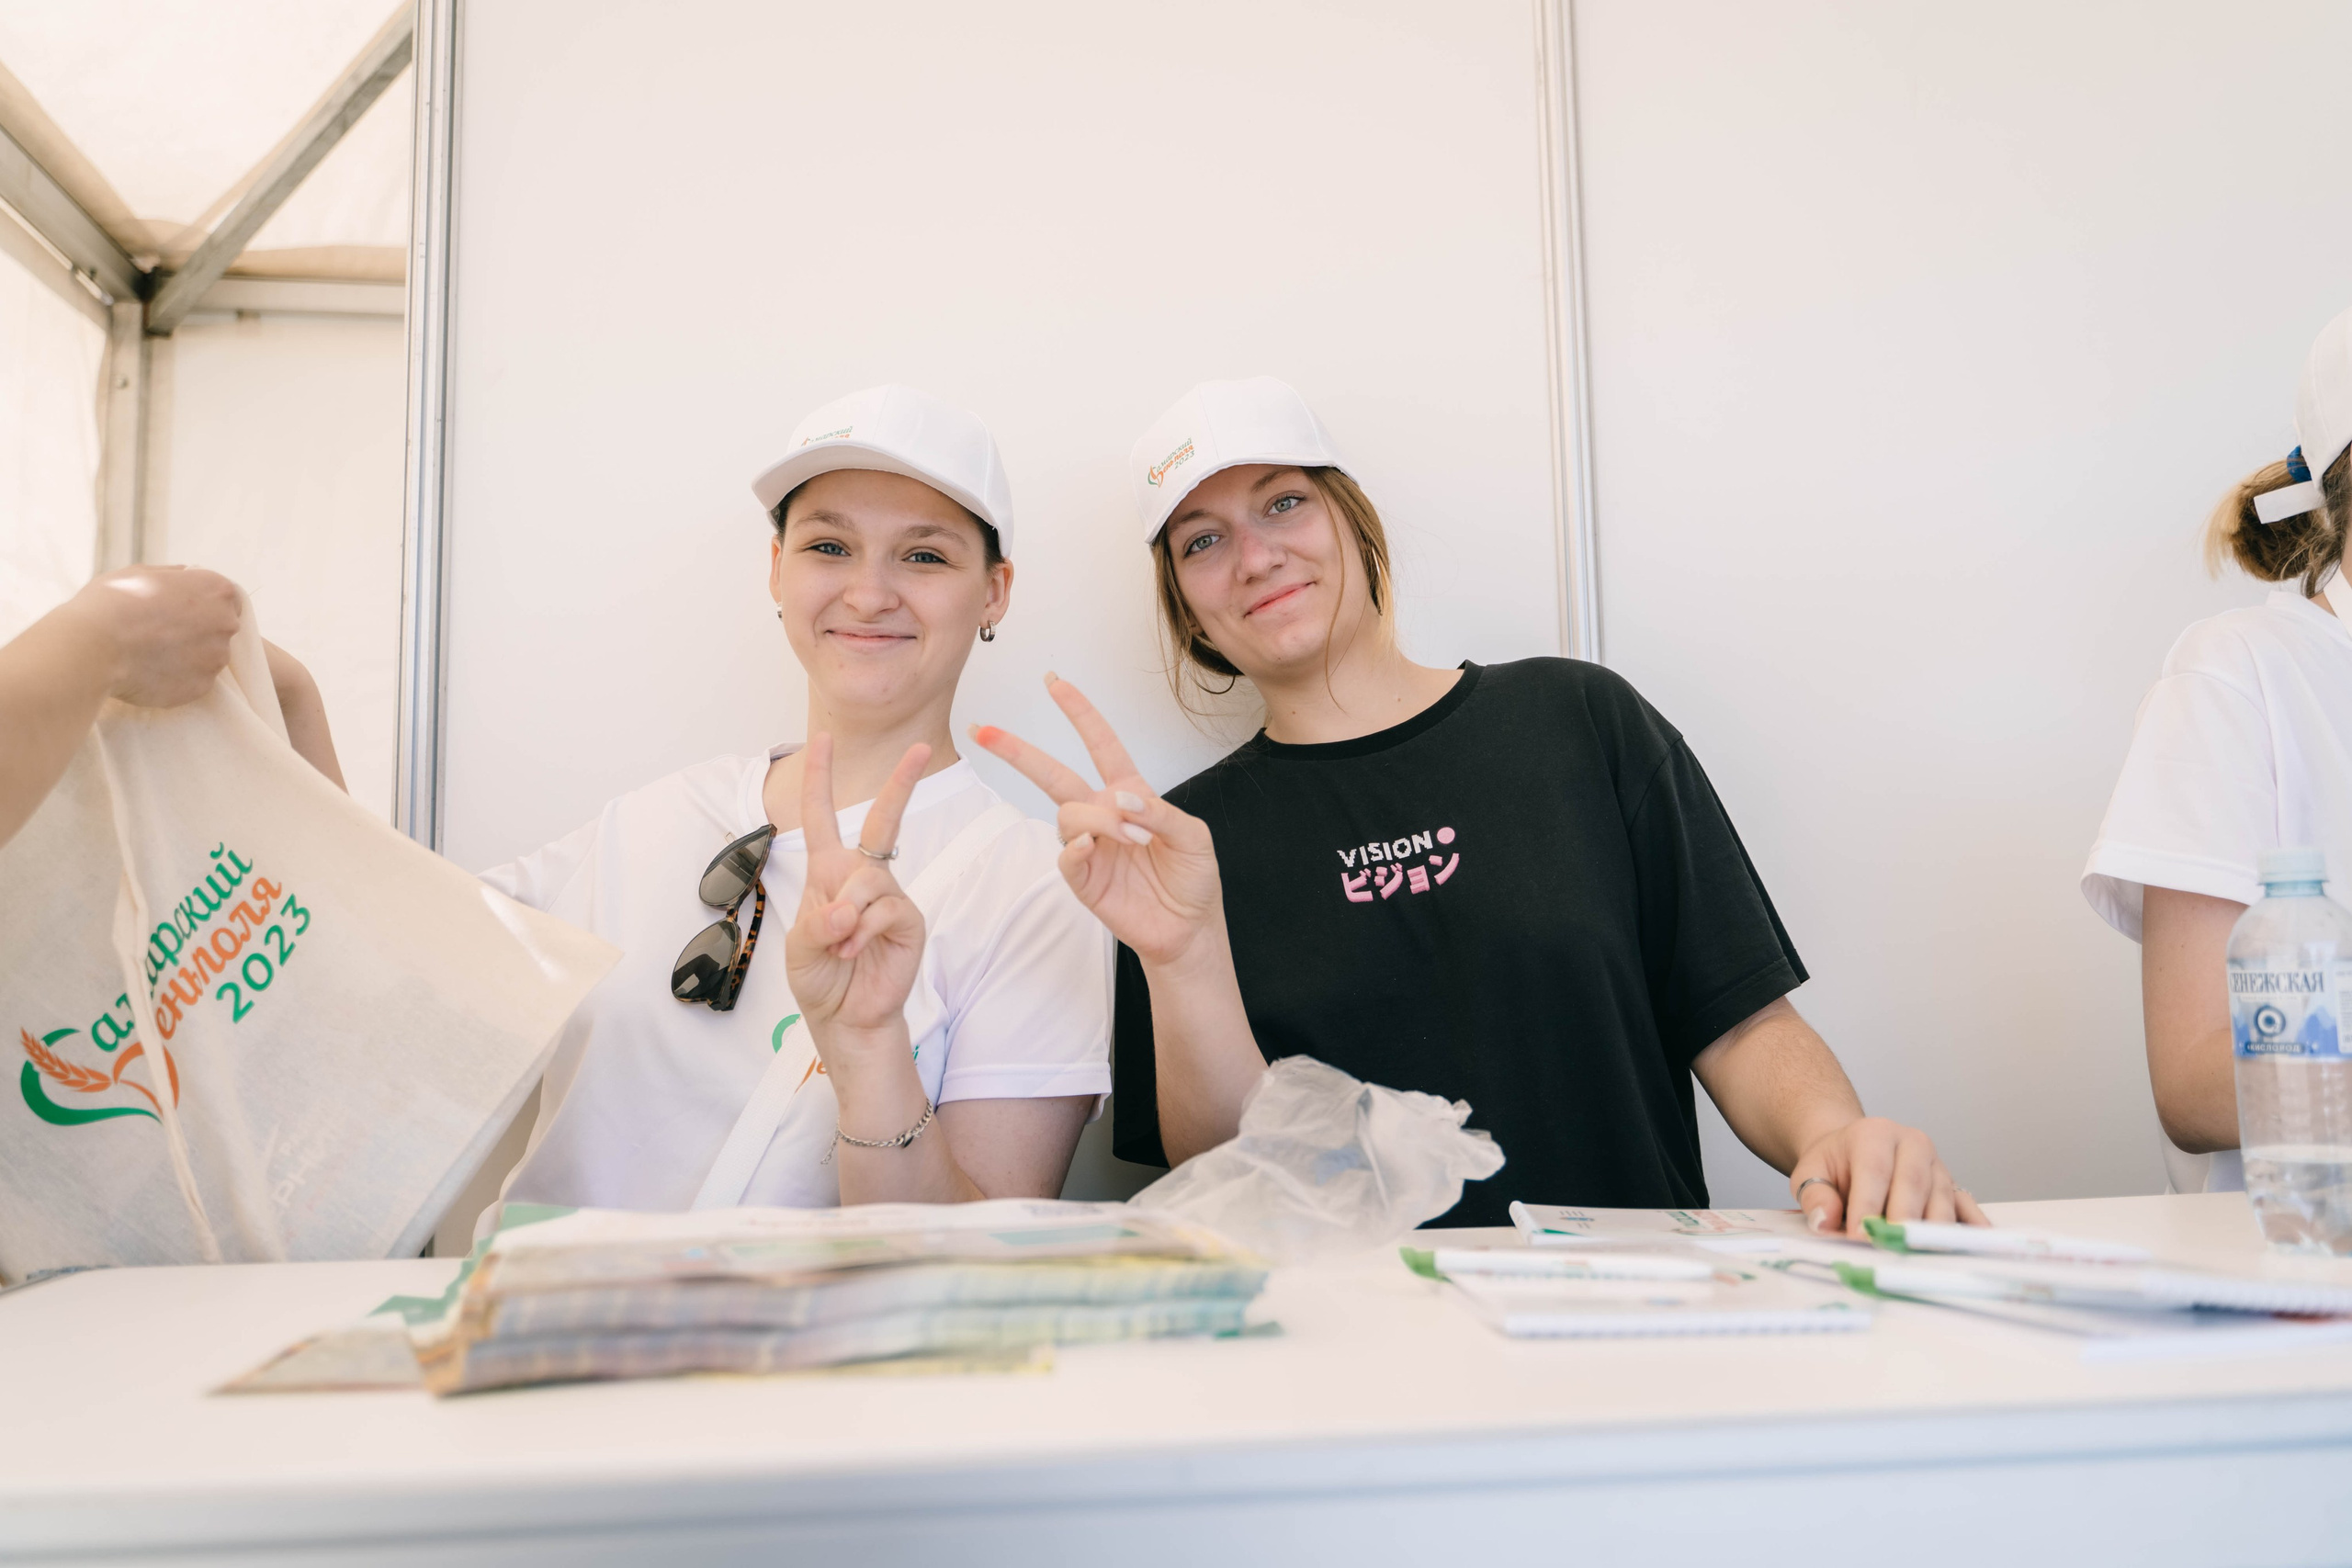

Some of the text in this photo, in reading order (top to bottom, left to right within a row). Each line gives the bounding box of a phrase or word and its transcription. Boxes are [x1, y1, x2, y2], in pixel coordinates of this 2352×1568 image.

[1174, 449, 1195, 470] 2023
[1337, 830, 1433, 867] VISION
[1340, 852, 1460, 902] ビジョン
[216, 893, 311, 1023] 2023
